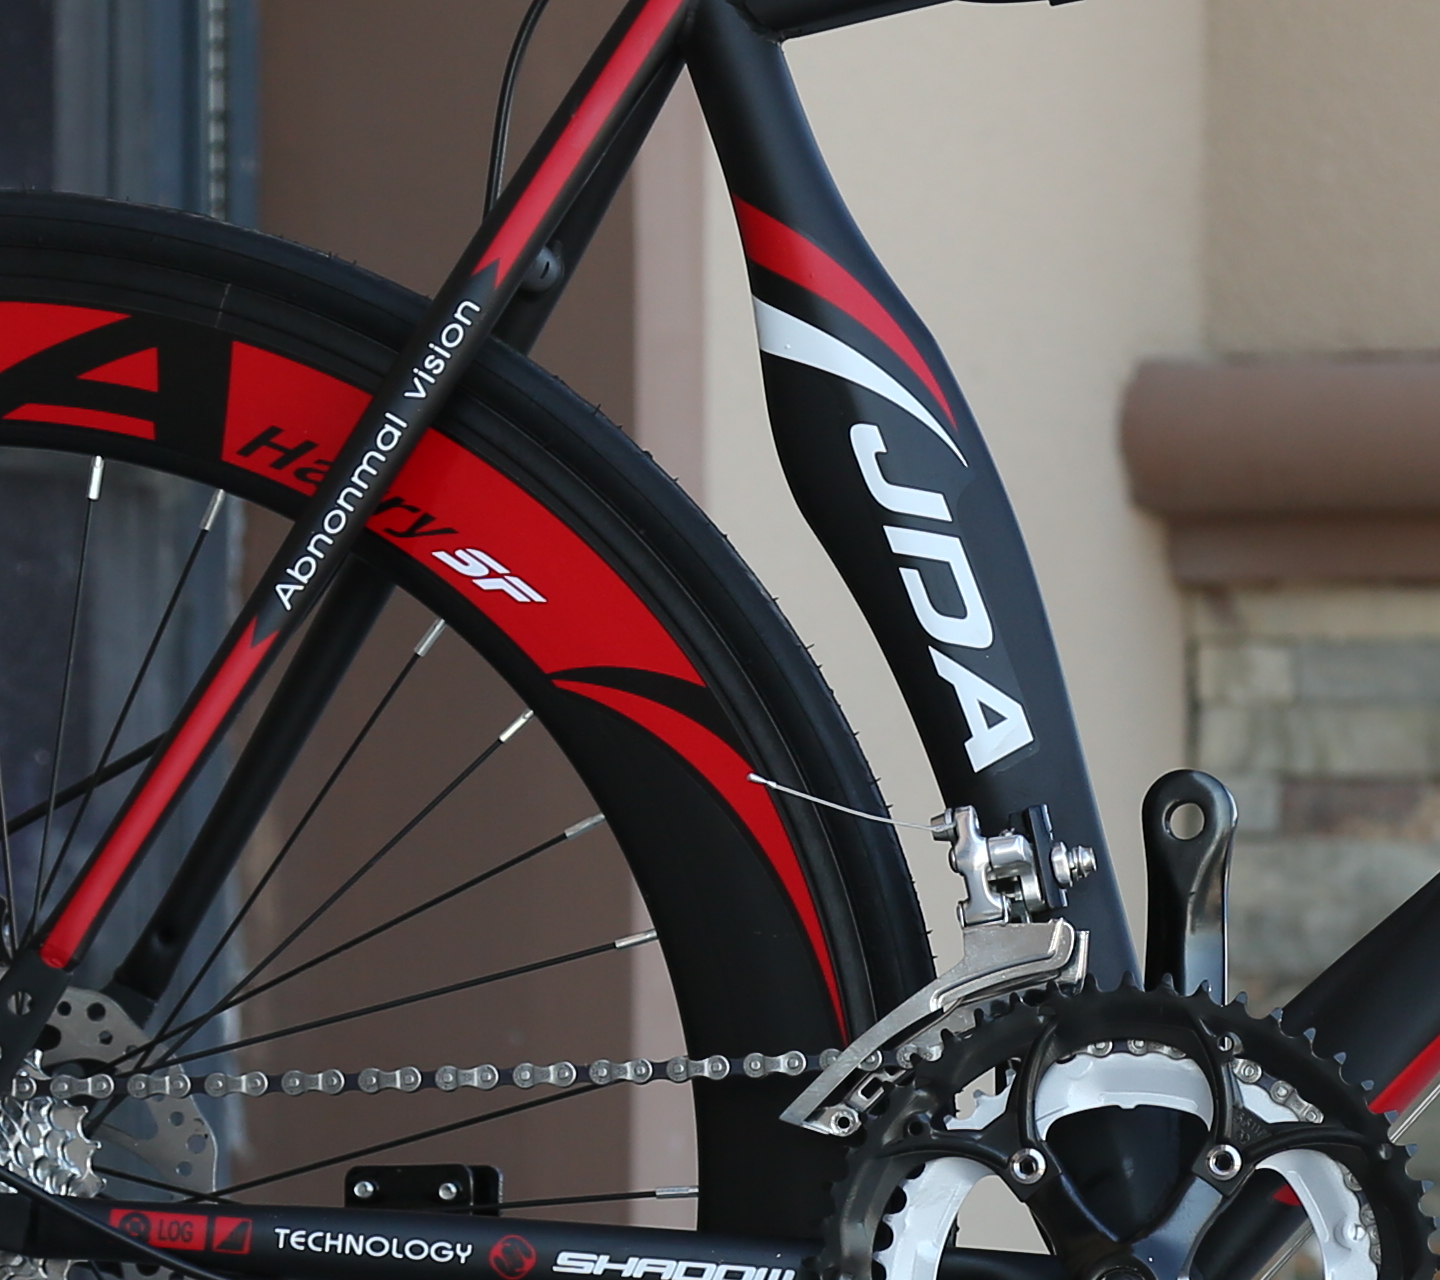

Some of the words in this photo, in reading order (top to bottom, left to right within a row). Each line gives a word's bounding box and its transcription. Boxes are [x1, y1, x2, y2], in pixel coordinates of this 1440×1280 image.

[275, 413, 407, 610] Abnonmal
[404, 300, 480, 398] vision
[432, 548, 547, 602] SF
[275, 1228, 473, 1264] TECHNOLOGY
